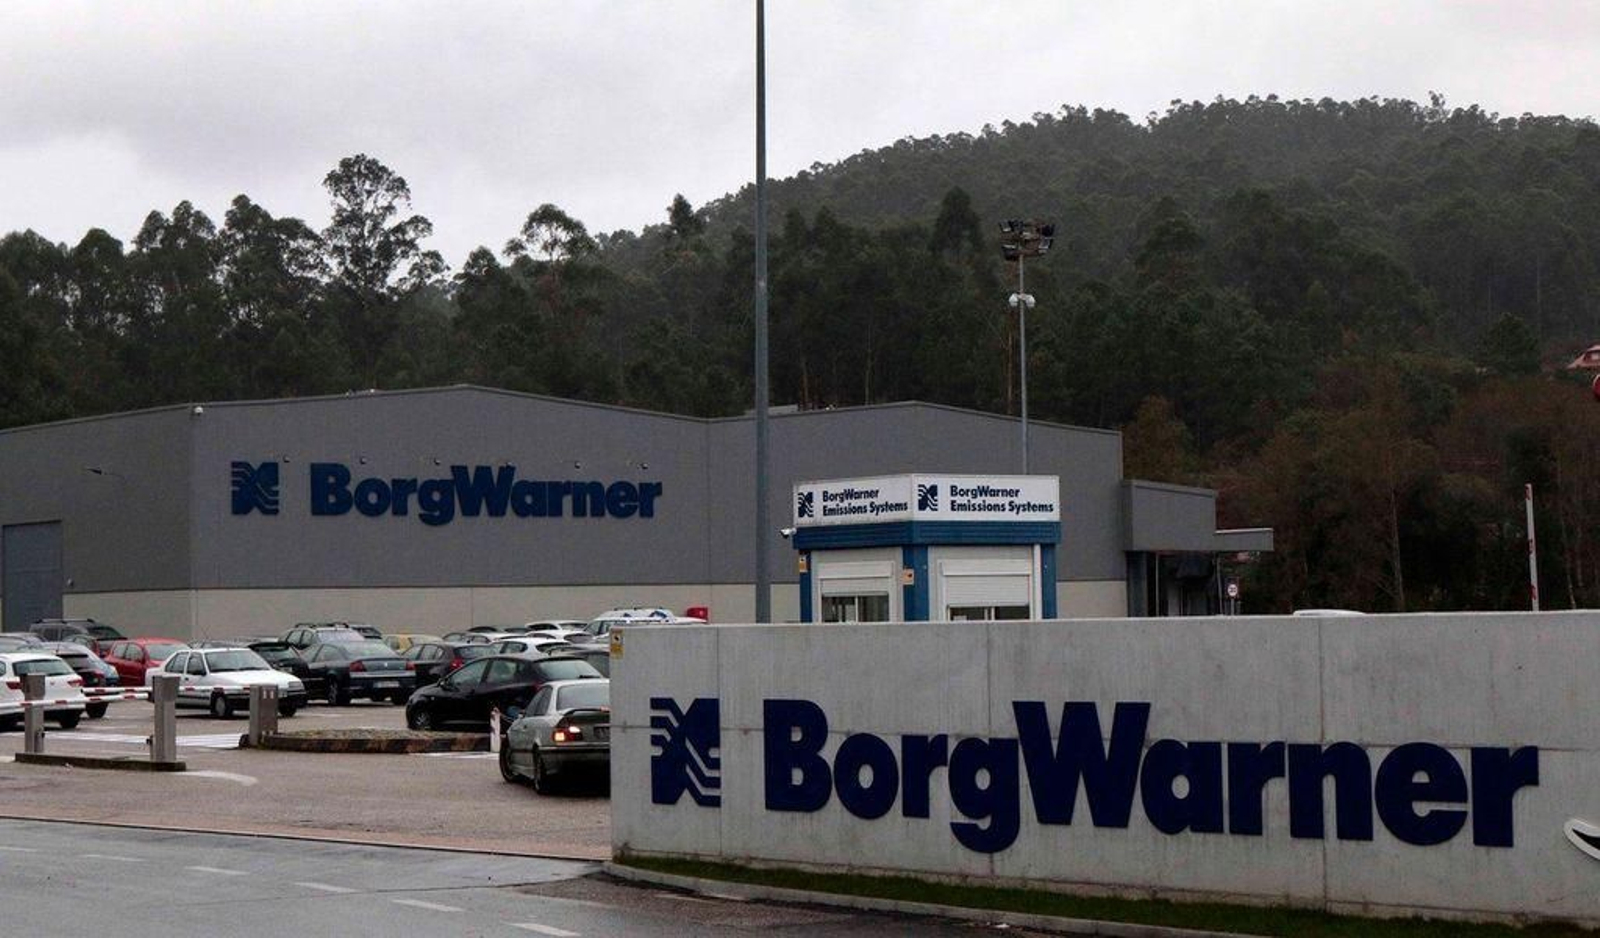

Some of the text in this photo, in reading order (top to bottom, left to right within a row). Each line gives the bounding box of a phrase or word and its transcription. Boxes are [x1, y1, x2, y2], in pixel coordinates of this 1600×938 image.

[309, 462, 663, 526] BorgWarner
[823, 488, 880, 502] BorgWarner
[950, 485, 1021, 499] BorgWarner
[823, 501, 908, 517] Emissions Systems
[950, 499, 1054, 515] Emissions Systems
[763, 698, 1539, 853] BorgWarner
